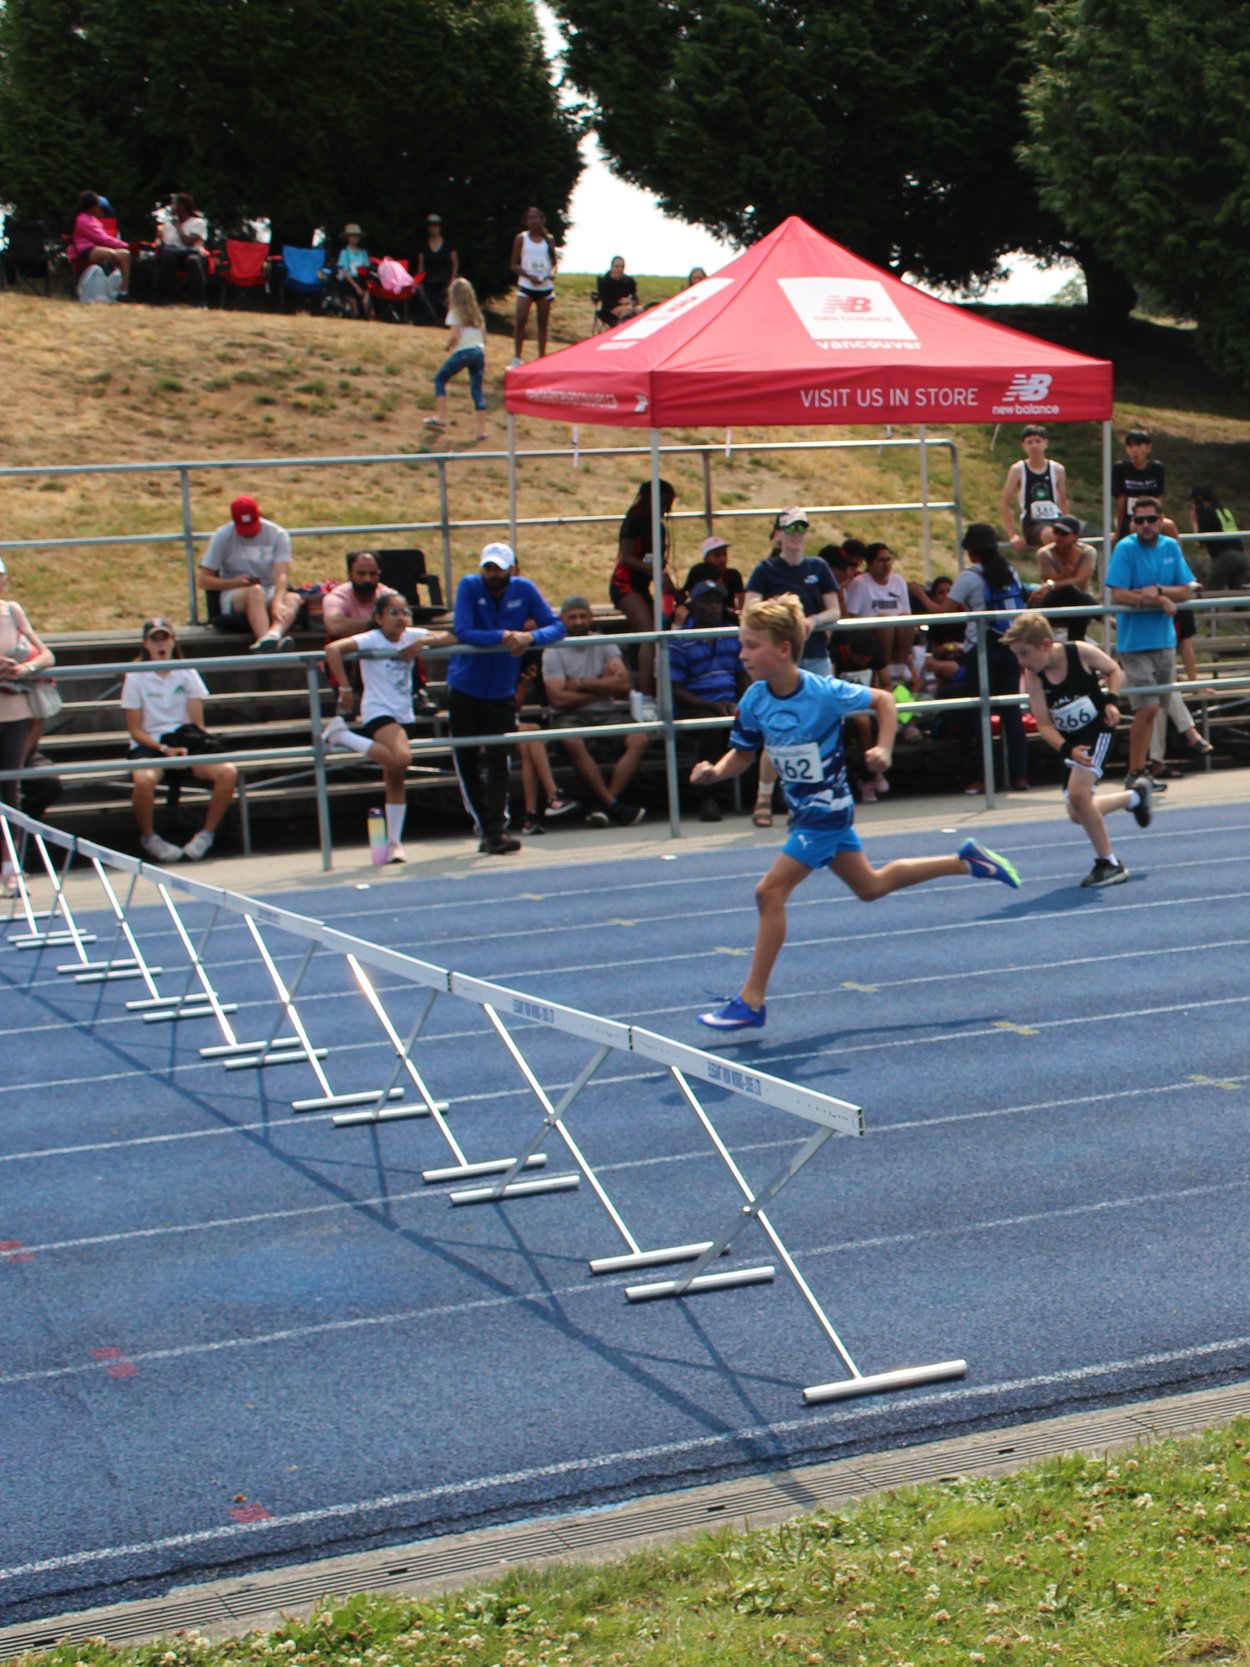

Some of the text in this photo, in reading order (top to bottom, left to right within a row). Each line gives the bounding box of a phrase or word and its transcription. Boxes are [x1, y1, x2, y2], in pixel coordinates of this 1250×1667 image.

[815, 340, 923, 350] vancouver
[800, 387, 979, 408] VISIT US IN STORE
[991, 403, 1060, 415] new balance
[1055, 708, 1091, 729] 266
